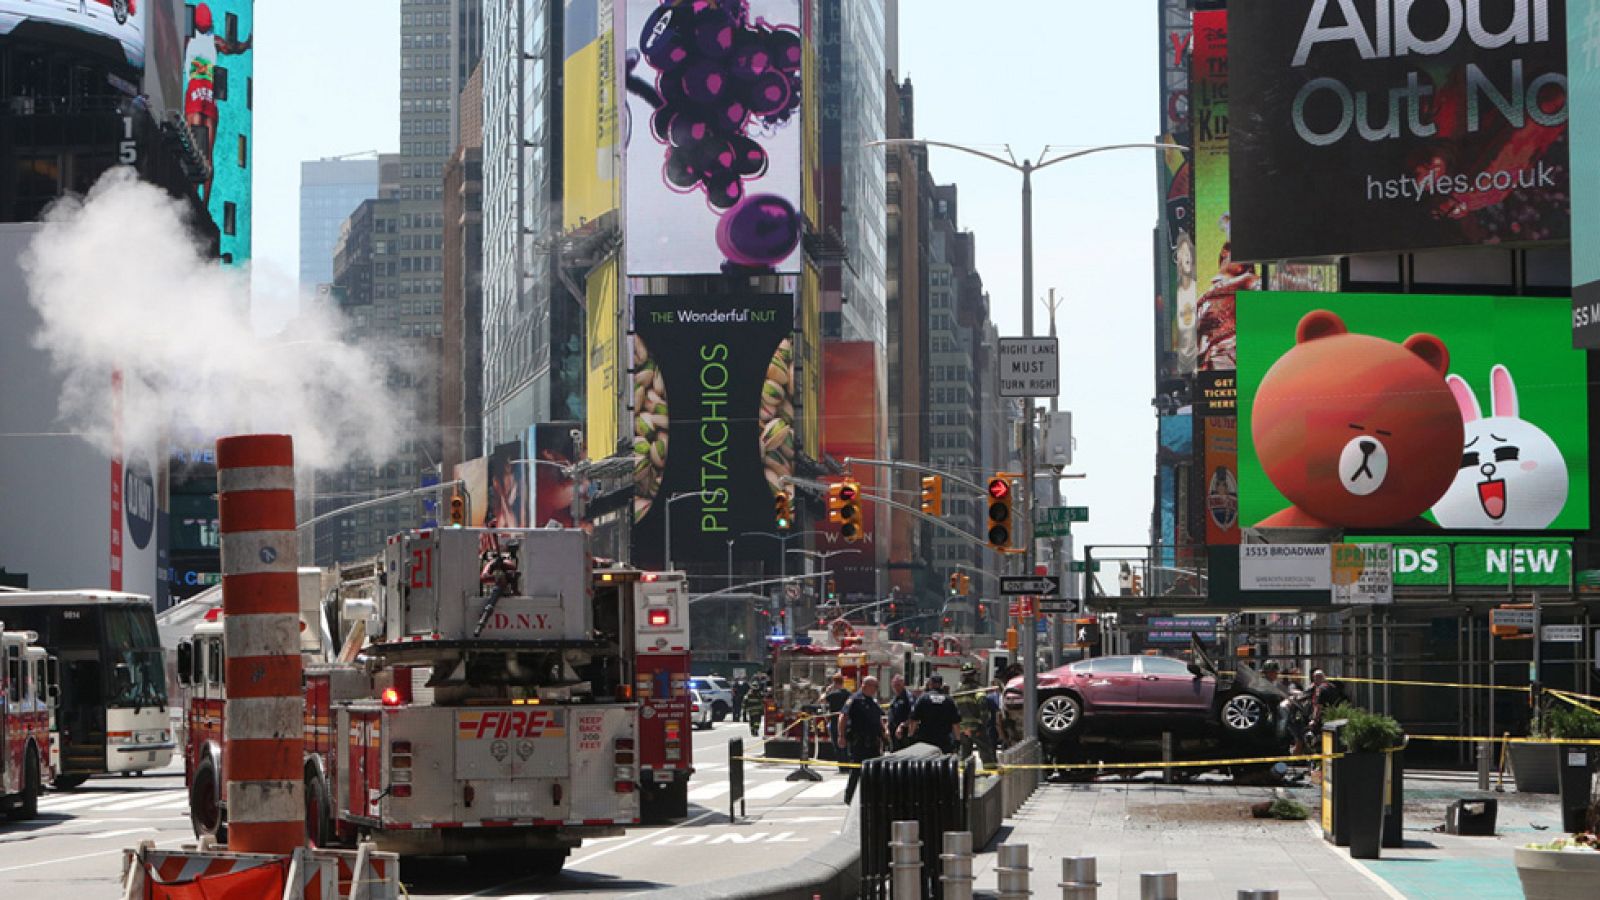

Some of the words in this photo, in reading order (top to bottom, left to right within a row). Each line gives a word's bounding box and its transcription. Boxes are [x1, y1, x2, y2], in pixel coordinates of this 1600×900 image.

[1291, 71, 1436, 146] Out
[1366, 160, 1555, 202] hstyles.co.uk
[650, 311, 673, 323] THE
[677, 308, 749, 323] Wonderful
[751, 309, 777, 322] NUT
[1000, 344, 1028, 355] RIGHT
[1031, 344, 1055, 355] LANE
[1011, 361, 1045, 373] MUST
[1001, 379, 1026, 390] TURN
[1029, 379, 1056, 390] RIGHT
[1214, 378, 1234, 388] GET
[1209, 399, 1235, 408] HERE
[700, 343, 729, 532] PISTACHIOS
[1245, 547, 1268, 557] 1515
[1270, 546, 1326, 557] BROADWAY
[1336, 547, 1388, 562] SPRING
[1485, 548, 1559, 573] NEW
[411, 547, 432, 589] 21
[1033, 582, 1051, 590] WAY
[476, 711, 549, 738] FIRE
[579, 716, 603, 724] KEEP
[579, 725, 602, 733] BACK
[580, 742, 601, 750] FEET
